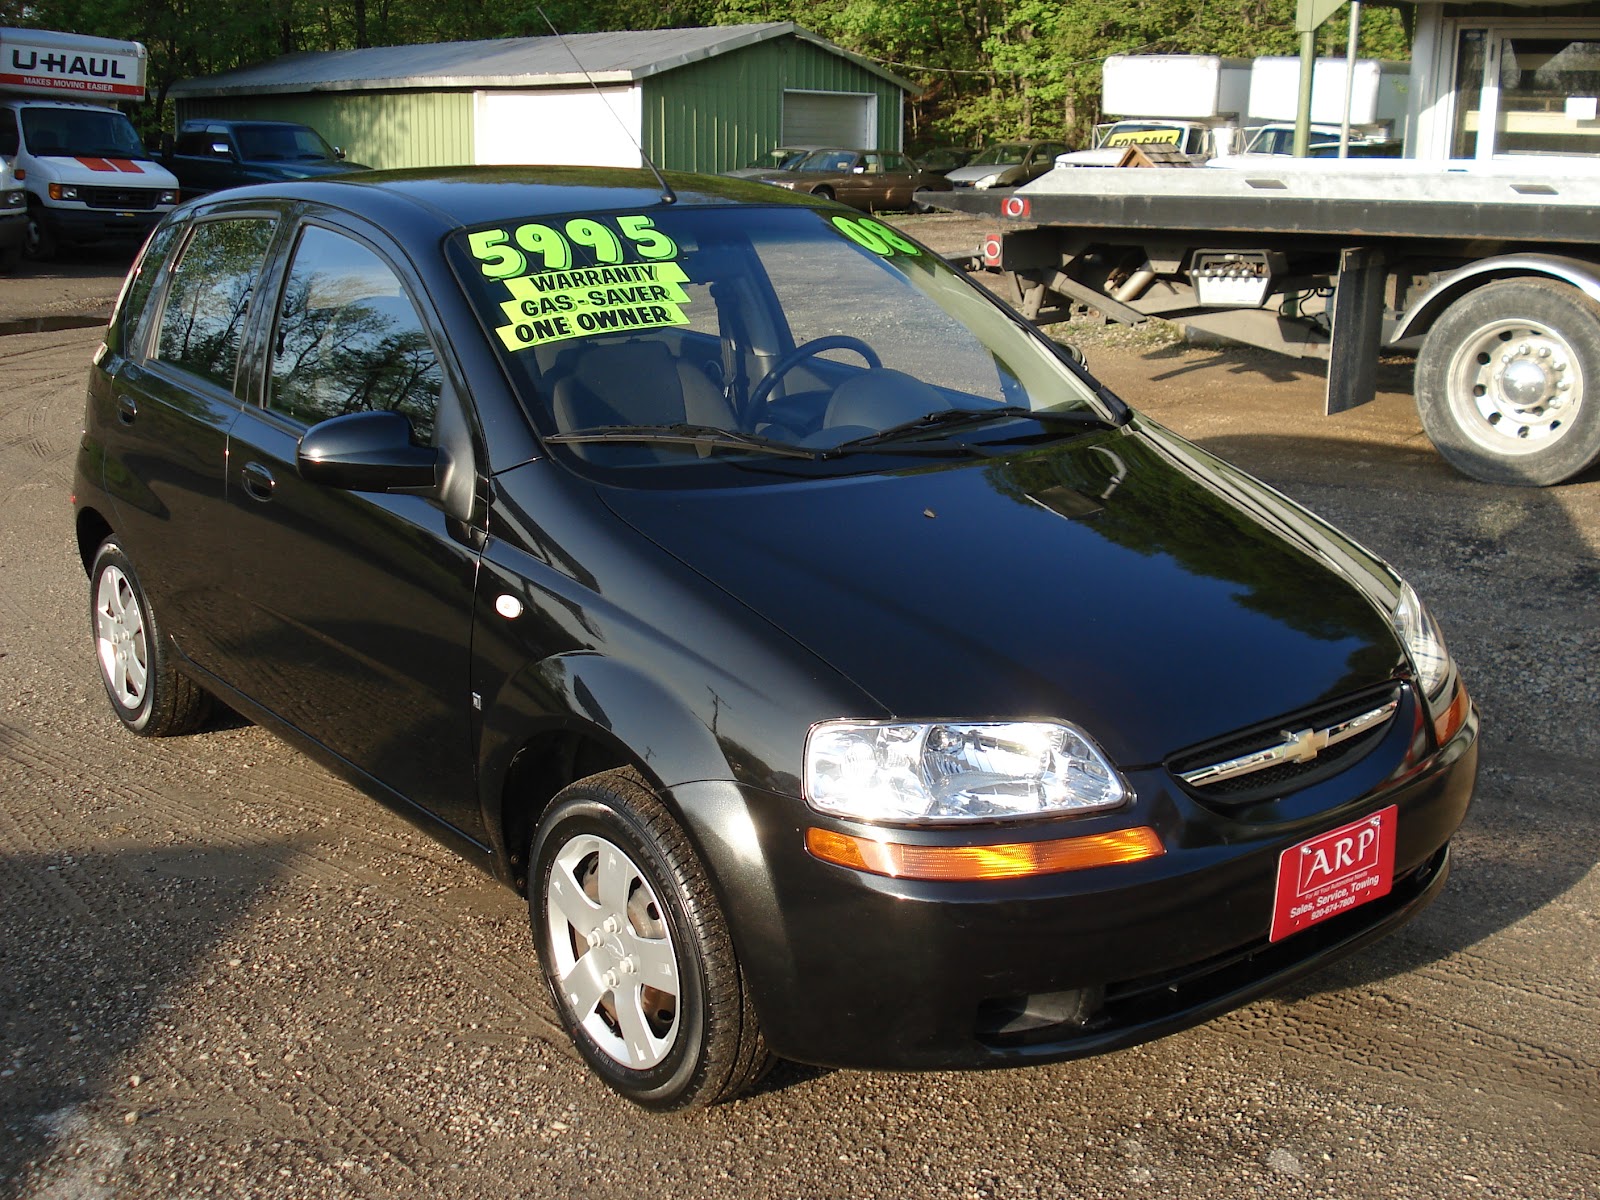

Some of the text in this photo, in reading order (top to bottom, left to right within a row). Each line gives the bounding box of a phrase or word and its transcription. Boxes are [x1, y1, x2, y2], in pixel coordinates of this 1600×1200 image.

[23, 76, 113, 92] MAKES MOVING EASIER
[468, 215, 677, 279] 5995
[831, 216, 922, 257] 08
[528, 265, 657, 293] WARRANTY
[520, 285, 670, 318] GAS-SAVER
[515, 305, 673, 344] ONE OWNER
[1304, 827, 1375, 888] ARP
[1290, 874, 1379, 918] Sales, Service, Towing
